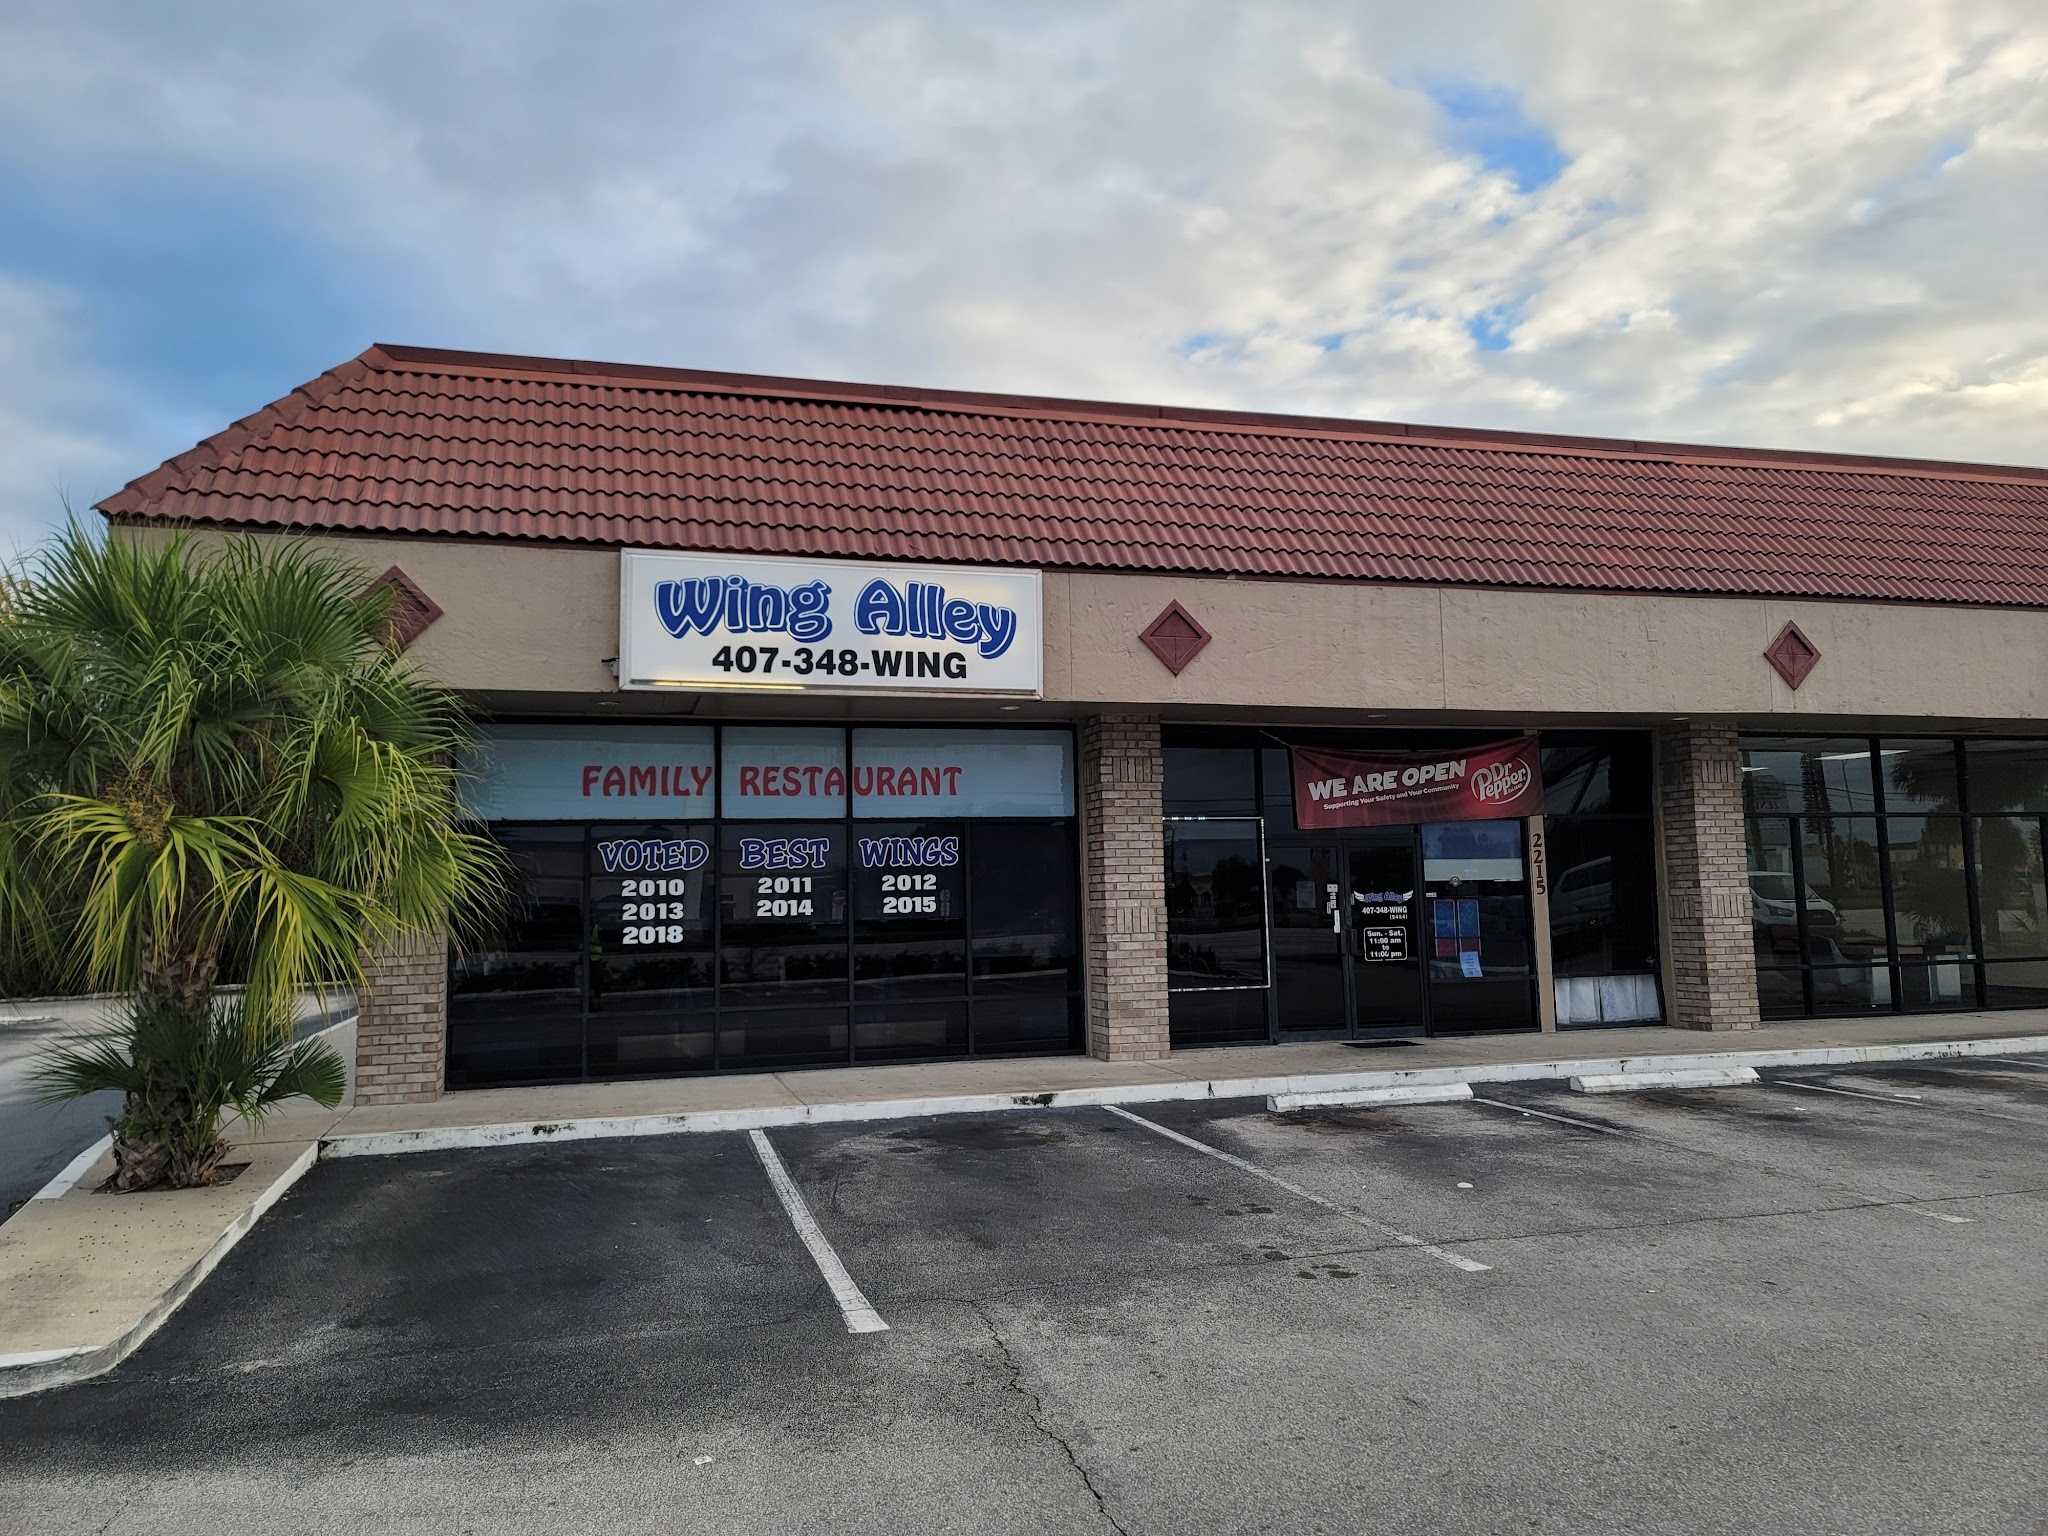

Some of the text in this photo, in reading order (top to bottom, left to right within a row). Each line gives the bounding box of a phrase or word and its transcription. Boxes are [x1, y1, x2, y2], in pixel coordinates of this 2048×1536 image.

[654, 574, 1017, 659] Wing Alley
[712, 645, 967, 679] 407-348-WING
[582, 765, 962, 796] FAMILY RESTAURANT
[1308, 759, 1467, 801] WE ARE OPEN
[1490, 762, 1512, 782] Dr
[1471, 768, 1526, 801] Pepper
[1323, 782, 1460, 811] Supporting Your Safety and Your Community
[598, 836, 959, 872] VOTED BEST WINGS
[1532, 833, 1546, 895] 2215
[621, 878, 685, 897] 2010
[757, 876, 812, 894] 2011
[881, 874, 937, 891] 2012
[622, 902, 684, 920] 2013
[756, 899, 813, 917] 2014
[883, 896, 937, 914] 2015
[1362, 906, 1408, 914] 407-348-WING
[622, 925, 684, 945] 2018
